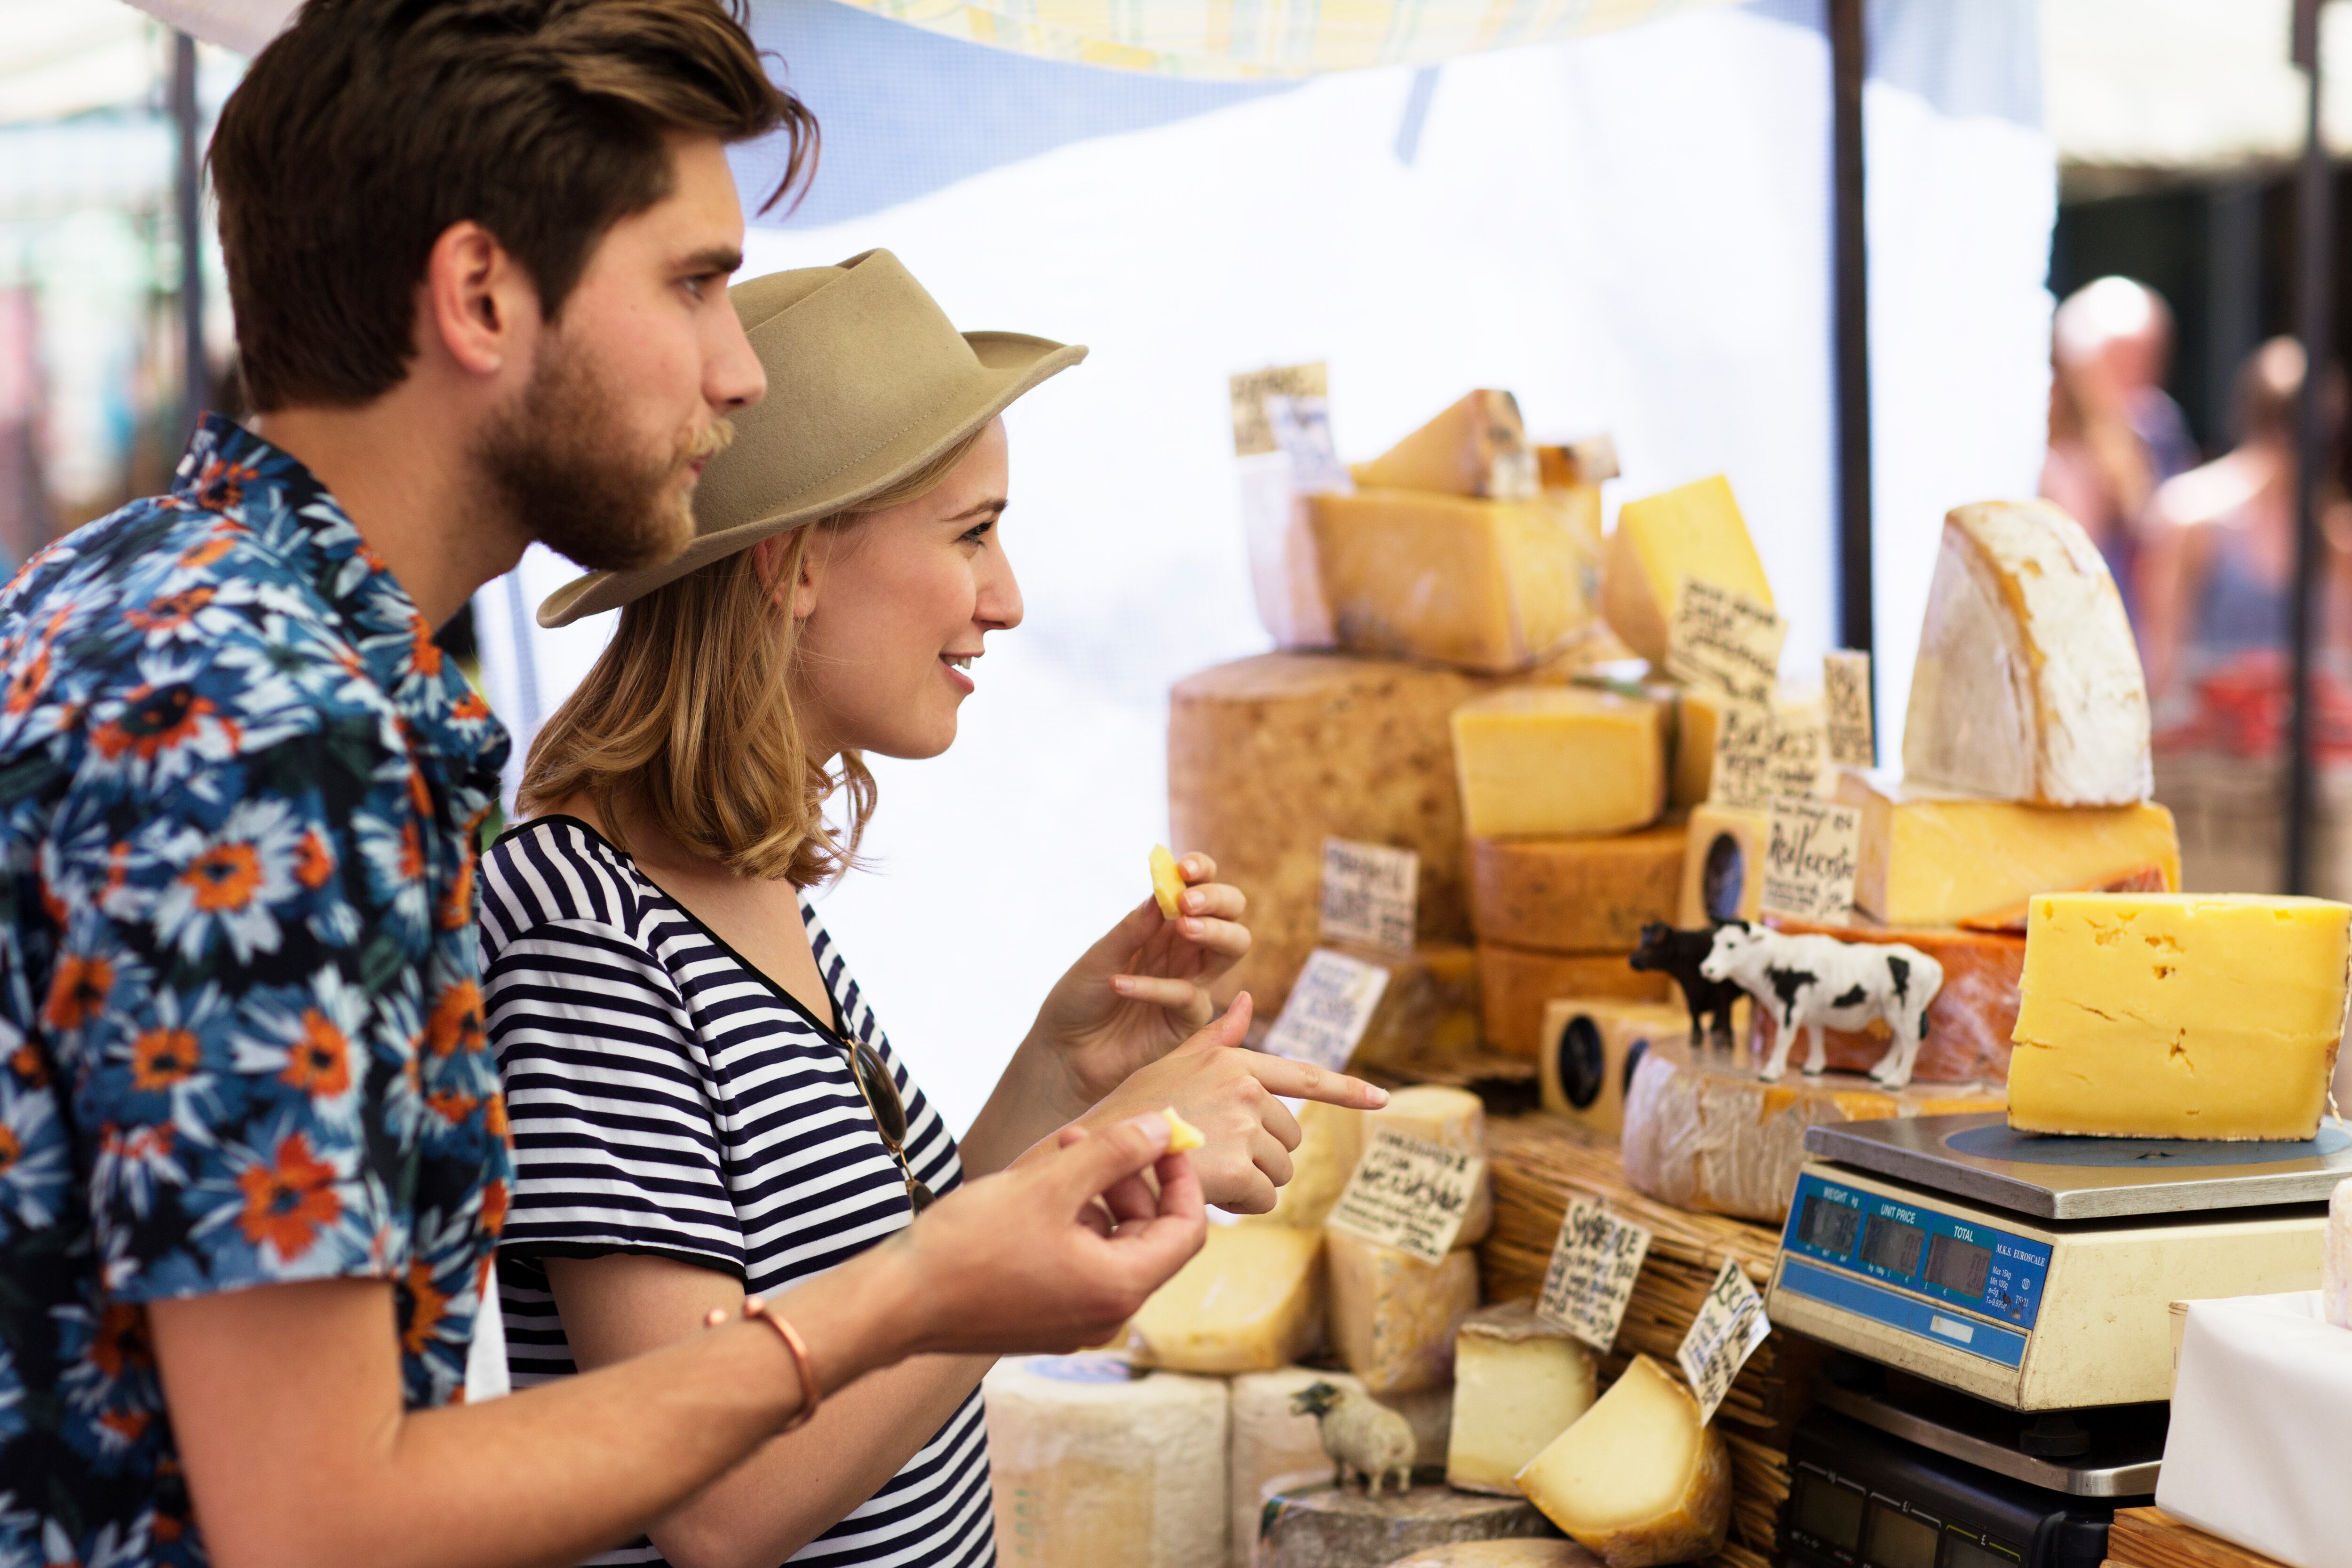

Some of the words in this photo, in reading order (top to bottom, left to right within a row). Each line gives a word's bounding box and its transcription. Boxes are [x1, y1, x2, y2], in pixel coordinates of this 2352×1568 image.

[1823, 1186, 1848, 1203] WEIGHT
[1851, 1195, 1859, 1208] kg
[1881, 1204, 1896, 1218] UNIT
[1896, 1208, 1916, 1224] PRICE
[1954, 1225, 1973, 1242] TOTAL
[1996, 1244, 2011, 1257] M.K.S.
[2013, 1249, 2045, 1267] EUROSCALE
[1993, 1266, 2002, 1275] Max
[2002, 1269, 2011, 1280] 15kg
[1990, 1276, 1998, 1286] Min
[1998, 1280, 2008, 1291] 100g
[1988, 1287, 1999, 1298] e=5g
[1981, 1534, 1986, 1546] £
